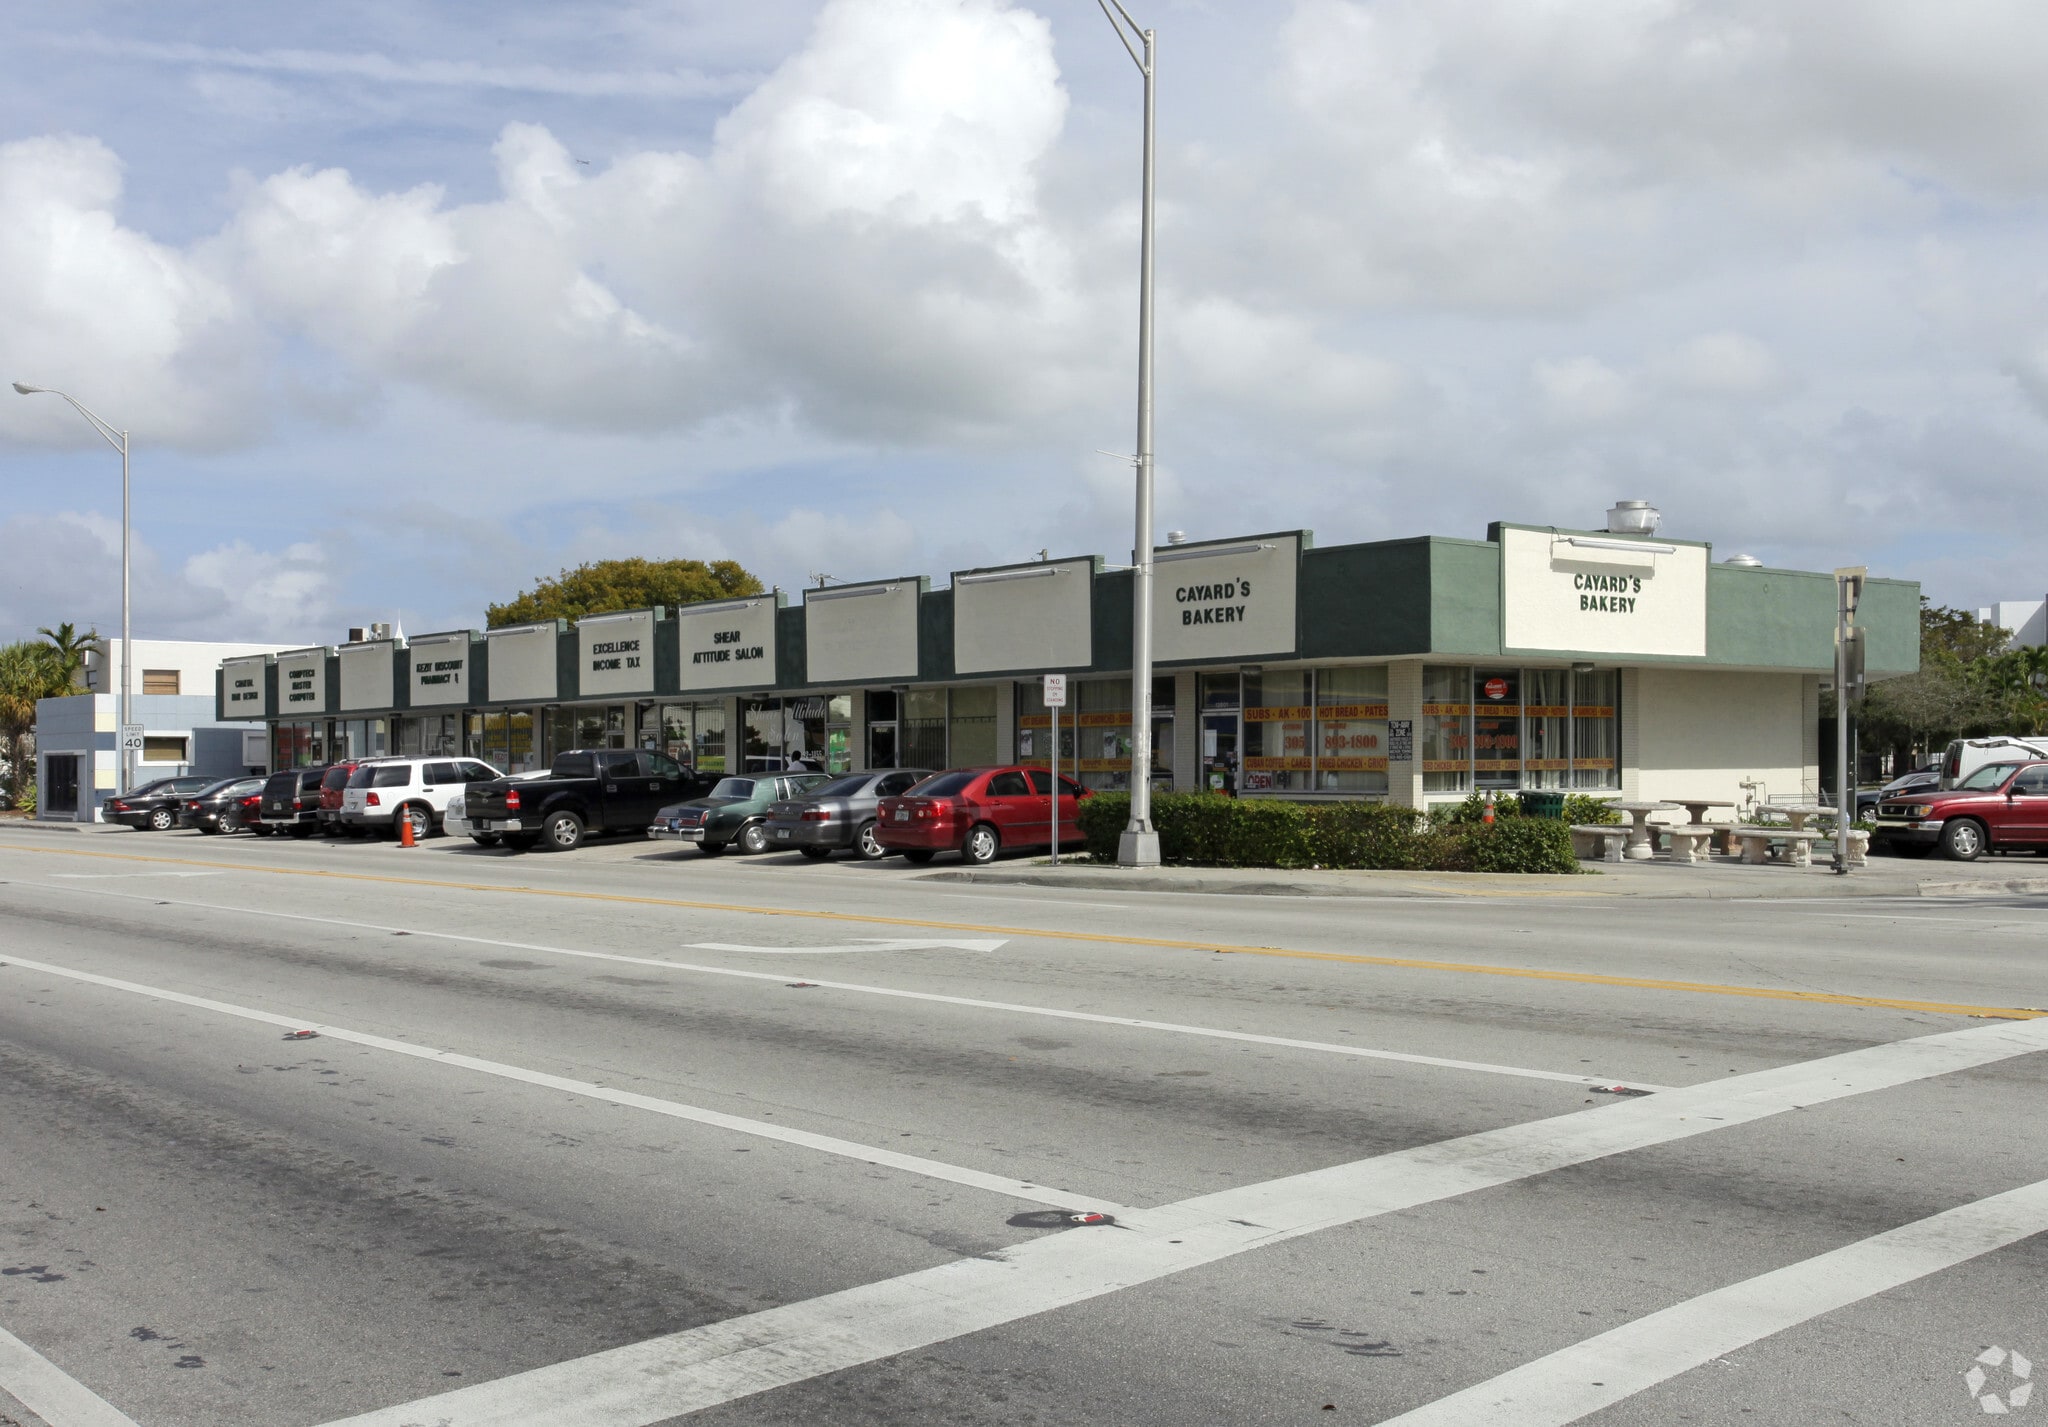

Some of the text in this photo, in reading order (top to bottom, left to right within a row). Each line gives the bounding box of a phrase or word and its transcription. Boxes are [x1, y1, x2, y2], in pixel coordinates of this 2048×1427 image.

[1176, 577, 1250, 603] CAYARD'S
[1574, 573, 1641, 593] CAYARD'S
[1580, 594, 1636, 613] BAKERY
[1182, 605, 1245, 625] BAKERY
[713, 631, 740, 644] SHEAR
[593, 640, 640, 655] EXCELLENCE
[693, 646, 763, 664] ATTITUDE SALON
[593, 656, 640, 671] INCOME TAX
[1246, 708, 1270, 720] SUBS
[1297, 707, 1312, 719] 100
[1319, 705, 1388, 718] HOT BREAD PATES
[125, 738, 142, 748] 40
[1285, 736, 1305, 749] 305
[1325, 735, 1377, 749] 893-1800
[1265, 757, 1285, 769] COFFEE
[1291, 757, 1312, 769] CAKES
[1319, 757, 1387, 769] FRIED CHICKEN GRIOT
[1248, 775, 1272, 789] OPEN
